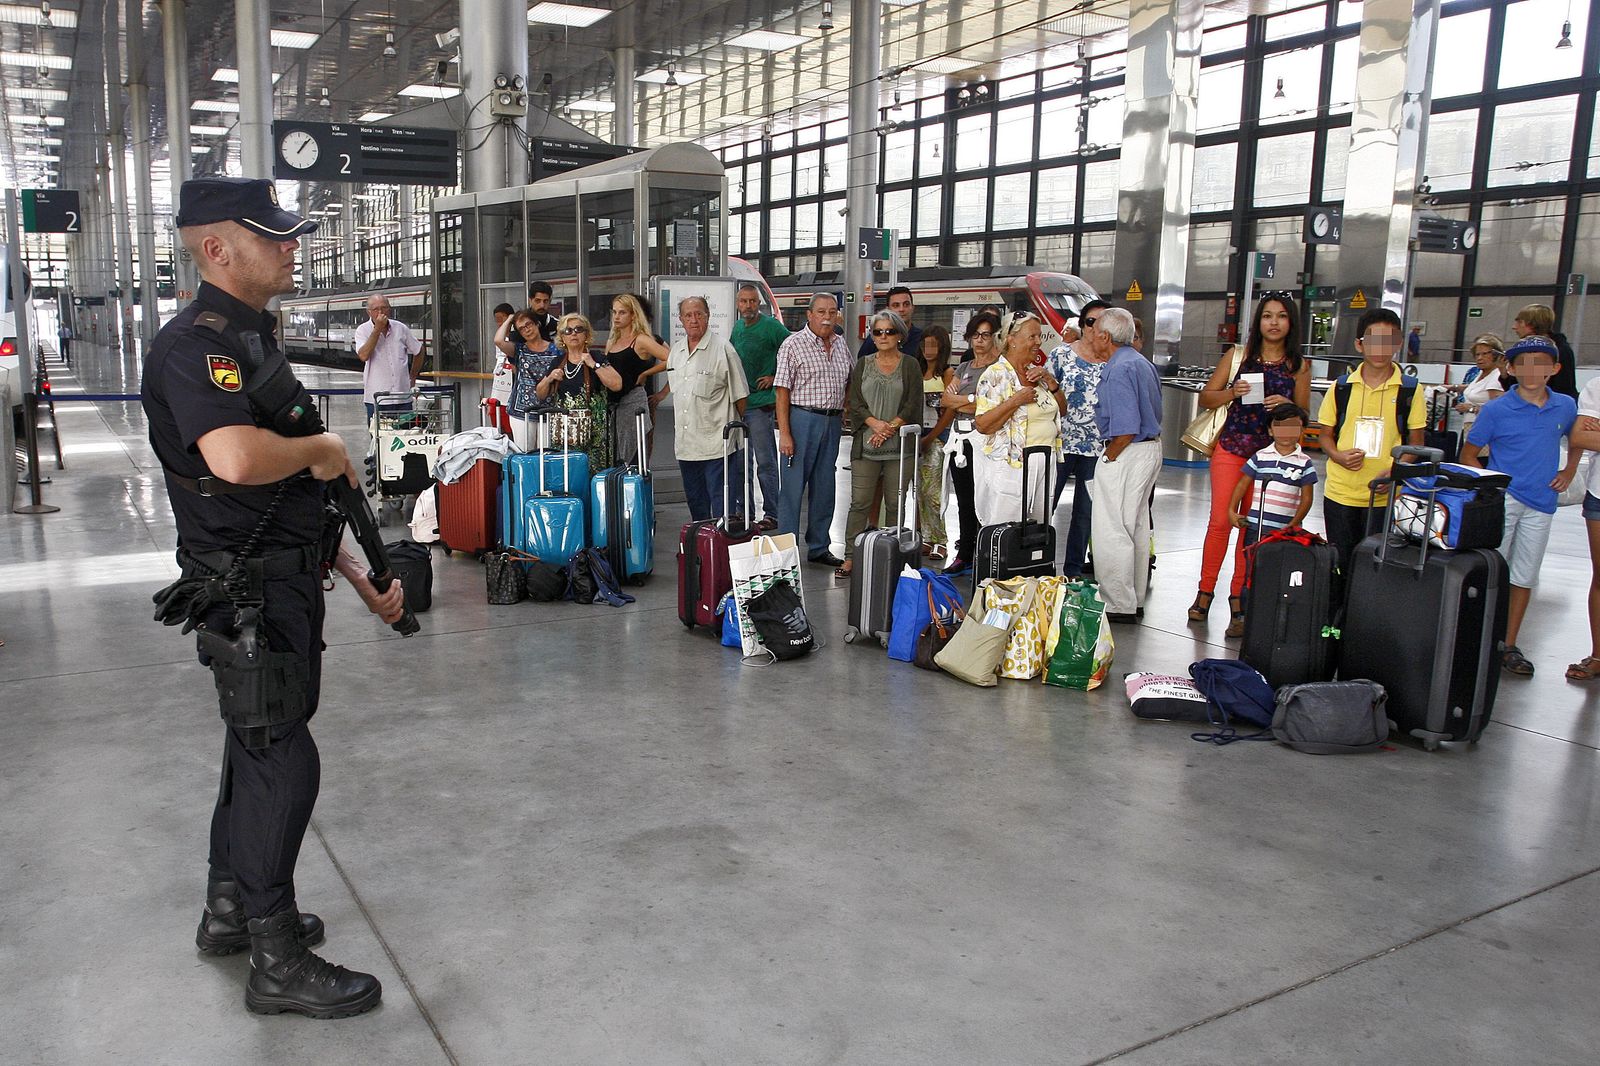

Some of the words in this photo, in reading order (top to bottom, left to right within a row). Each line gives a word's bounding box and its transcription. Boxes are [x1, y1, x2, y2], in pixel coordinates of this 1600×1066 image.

[339, 154, 351, 173] 2
[66, 212, 78, 231] 2
[1333, 227, 1339, 239] 4
[1452, 237, 1458, 249] 5
[860, 243, 867, 258] 3
[1267, 266, 1273, 278] 4
[408, 436, 440, 445] adif
